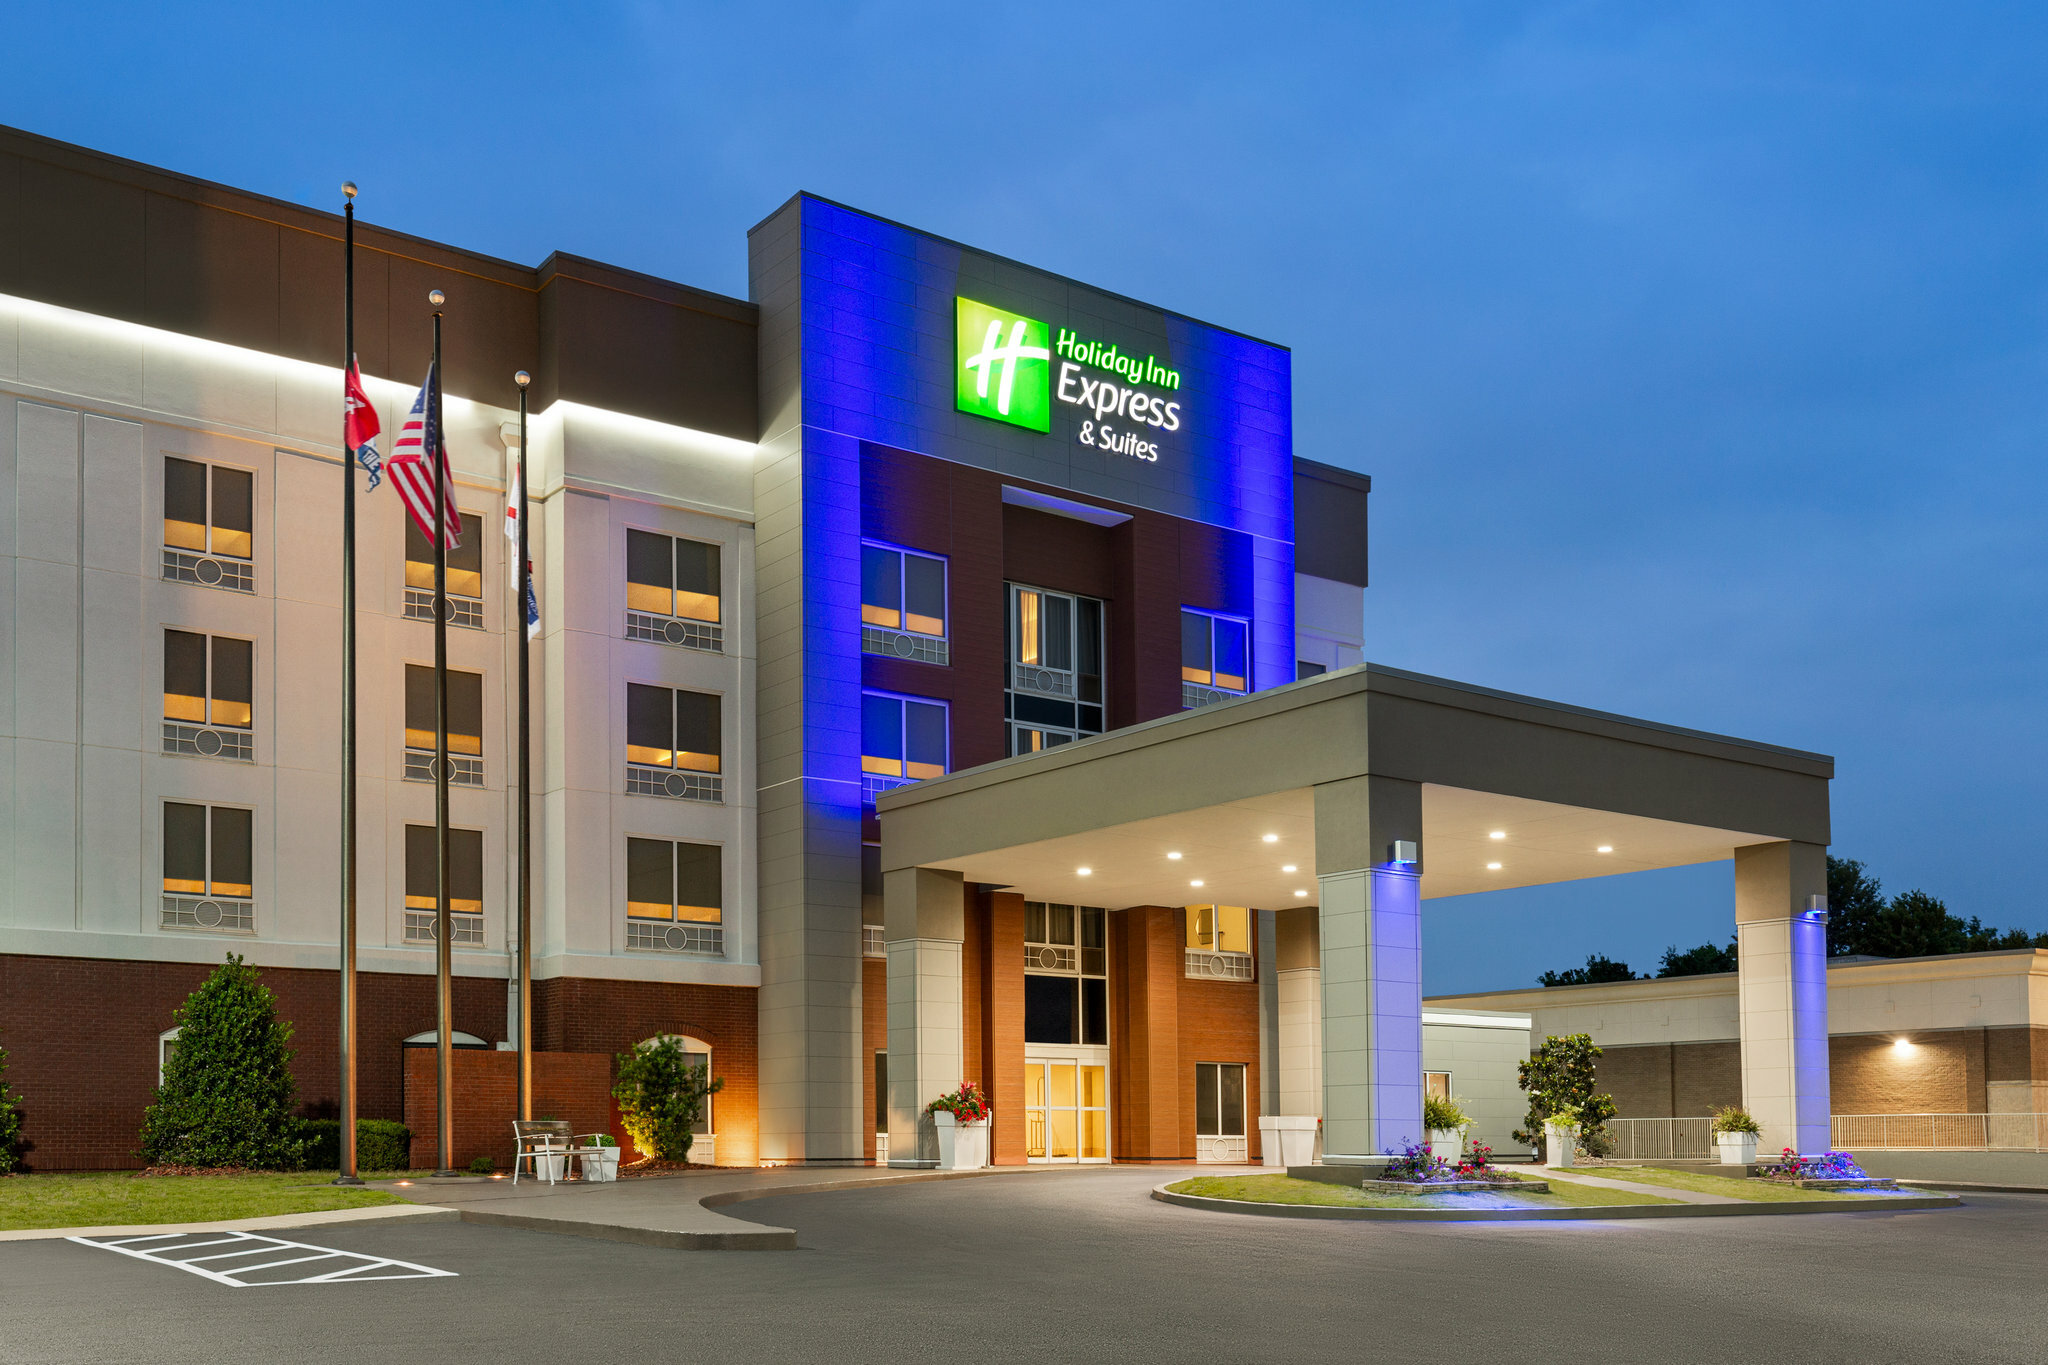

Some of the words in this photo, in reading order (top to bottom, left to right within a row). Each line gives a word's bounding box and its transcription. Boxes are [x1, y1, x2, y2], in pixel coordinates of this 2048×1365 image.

[1056, 328, 1144, 384] Holiday
[1146, 355, 1180, 390] Inn
[1057, 361, 1181, 431] Express
[1079, 420, 1095, 446] &
[1098, 425, 1158, 462] Suites
